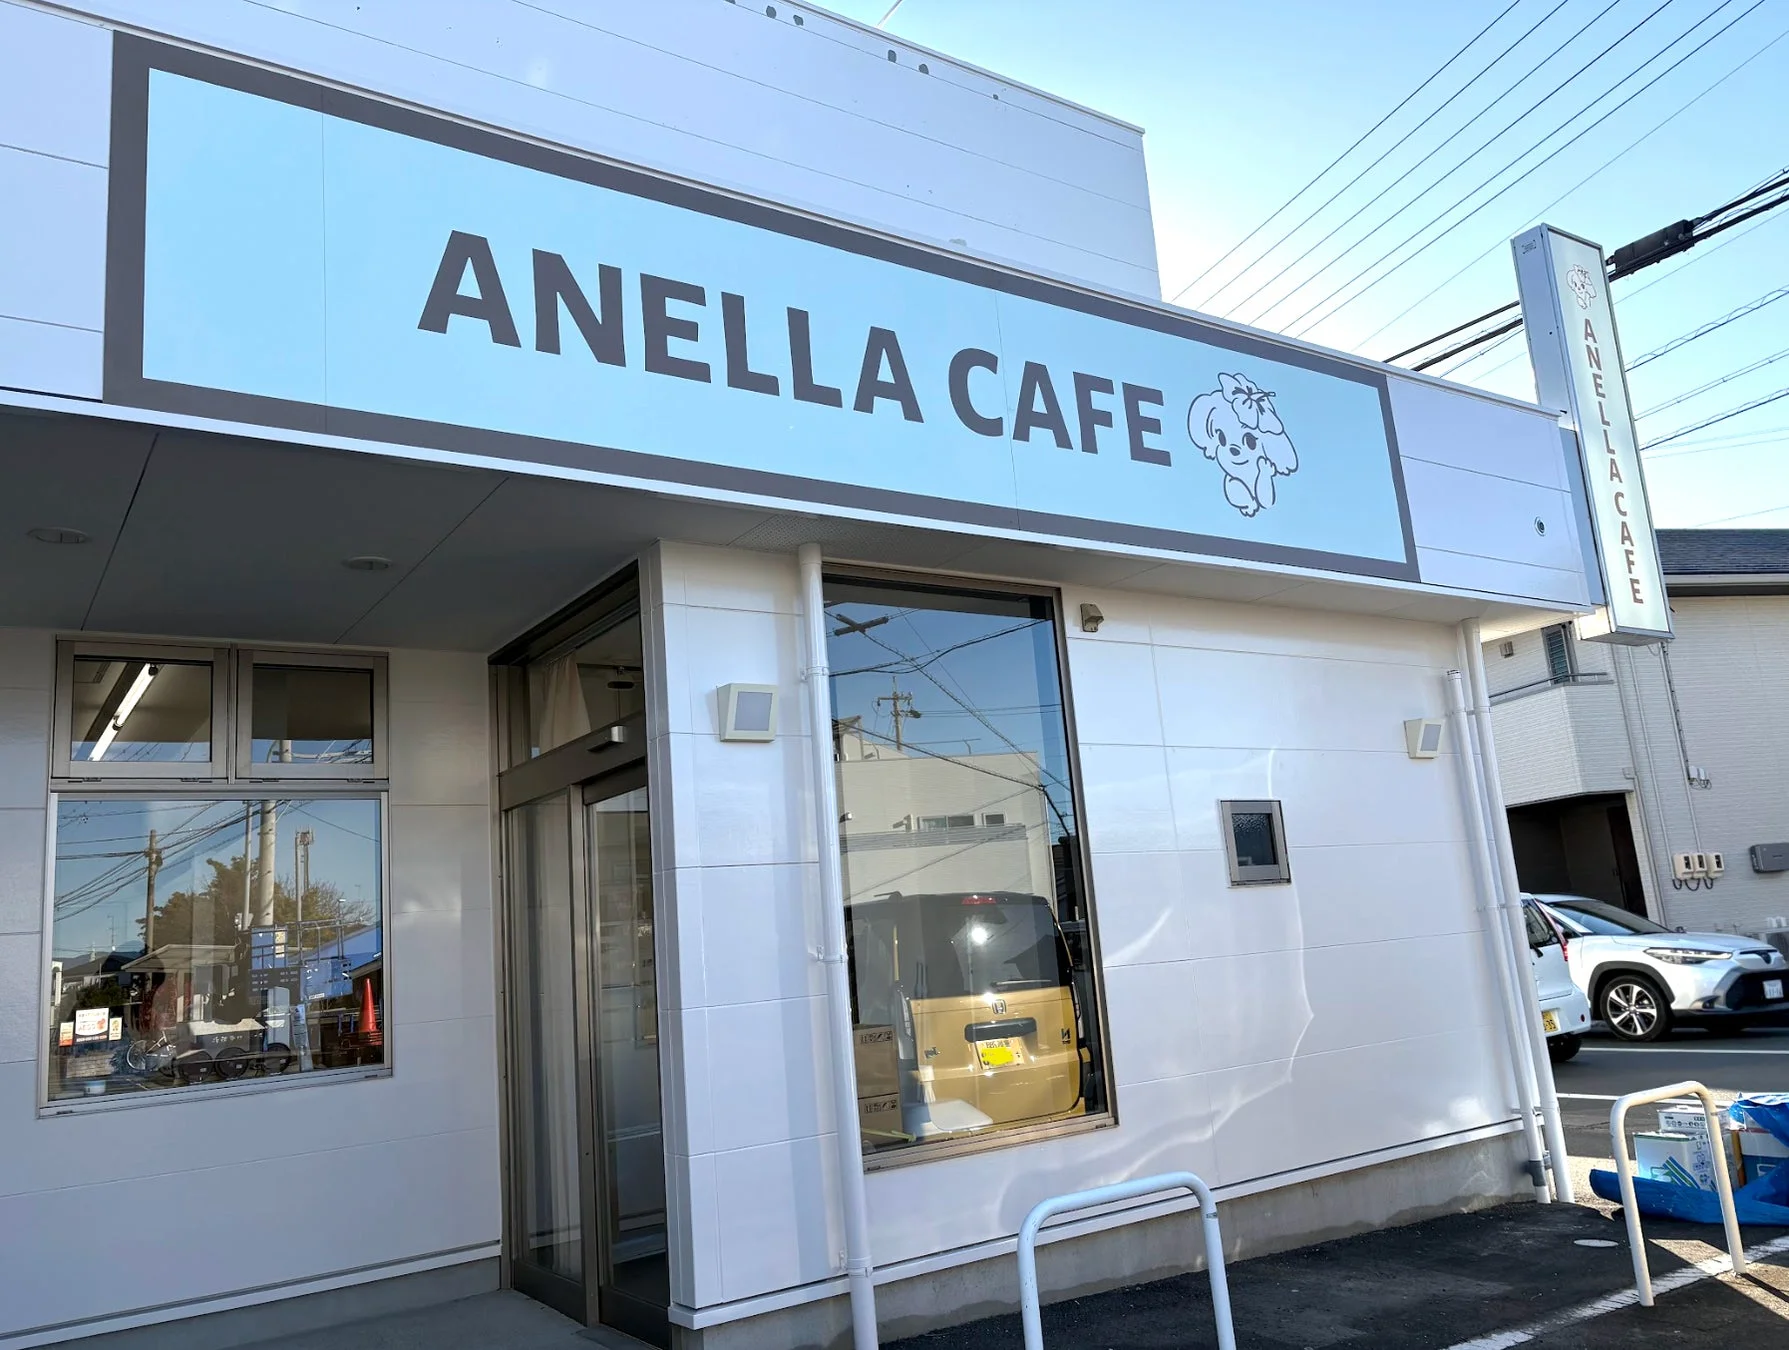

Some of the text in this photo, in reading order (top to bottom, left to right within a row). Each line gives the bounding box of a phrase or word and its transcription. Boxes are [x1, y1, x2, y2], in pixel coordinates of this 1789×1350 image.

[416, 229, 1172, 468] ANELLA CAFE
[1584, 318, 1644, 604] ANELLA CAFE
